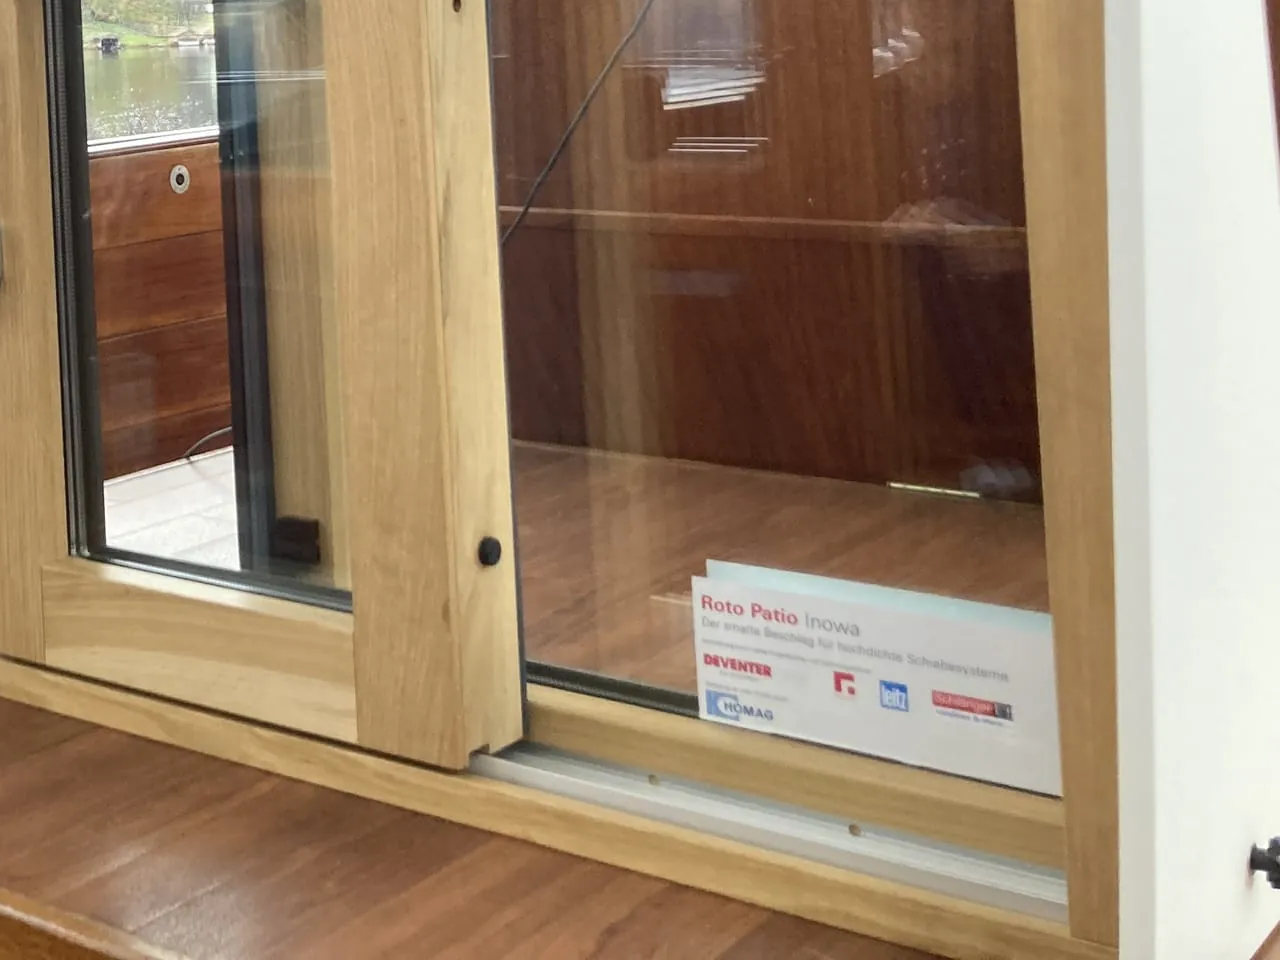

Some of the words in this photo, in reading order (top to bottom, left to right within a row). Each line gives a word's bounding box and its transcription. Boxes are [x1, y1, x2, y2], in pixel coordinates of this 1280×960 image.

[700, 593, 745, 616] Roto
[750, 602, 799, 626] Patio
[805, 611, 861, 637] Inowa
[702, 652, 773, 680] DEVENTER
[723, 701, 774, 722] HOMAG
